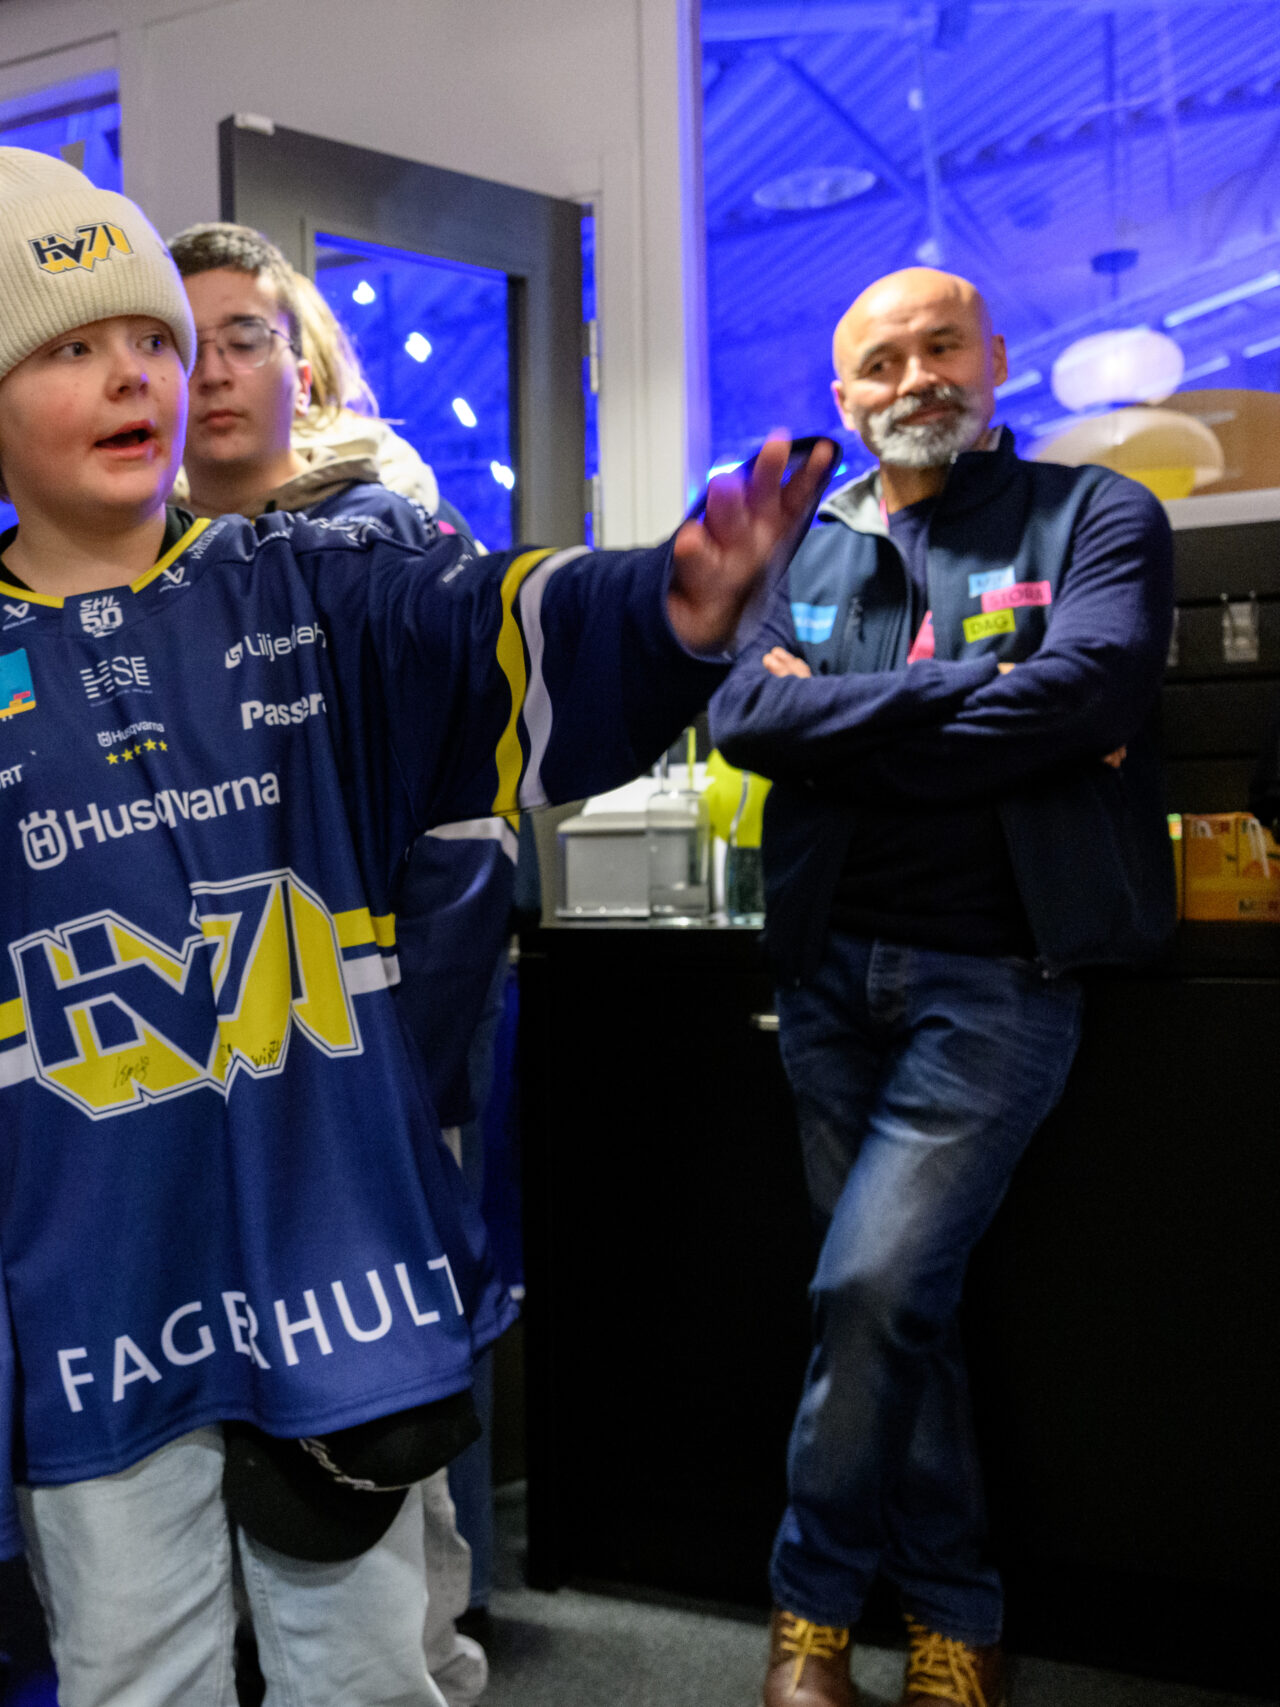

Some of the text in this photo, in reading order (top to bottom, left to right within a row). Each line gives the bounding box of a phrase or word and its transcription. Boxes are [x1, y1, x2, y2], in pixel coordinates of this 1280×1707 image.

[30, 223, 122, 268] HV71
[80, 595, 121, 614] SHL
[80, 606, 123, 633] 50
[969, 616, 1009, 635] DAG
[80, 656, 151, 699] HSE
[111, 721, 165, 743] Husqvarna
[65, 772, 280, 850] Husqvarna
[16, 872, 332, 1090] HV71
